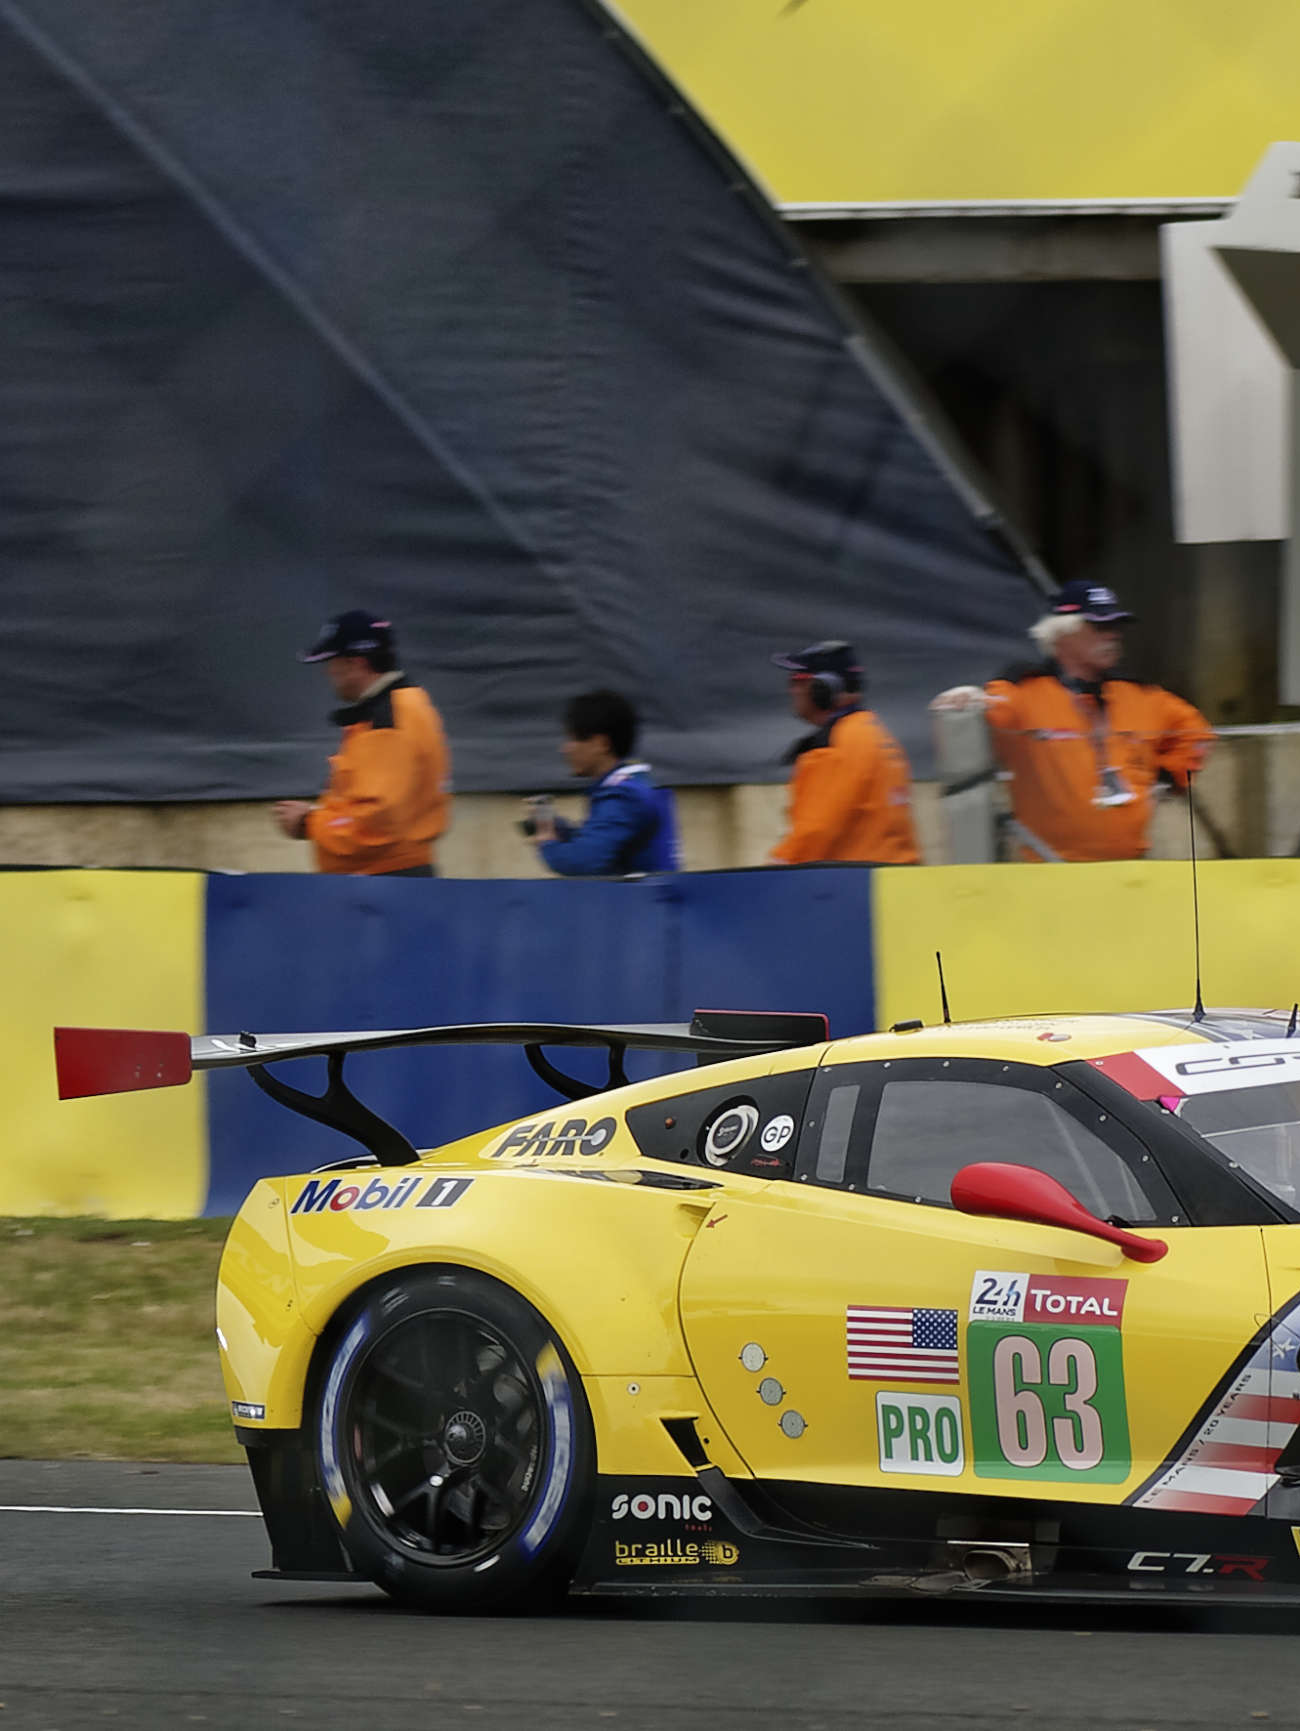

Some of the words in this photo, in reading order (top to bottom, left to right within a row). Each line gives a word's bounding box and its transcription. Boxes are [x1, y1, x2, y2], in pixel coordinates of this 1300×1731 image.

[491, 1117, 617, 1157] FARO
[764, 1126, 791, 1143] GP
[290, 1178, 421, 1214] Mobil
[972, 1305, 987, 1315] LE
[986, 1307, 1017, 1317] MANS
[1030, 1289, 1118, 1317] TOTAL
[993, 1335, 1105, 1471] 63
[881, 1404, 960, 1464] PRO
[1162, 1448, 1199, 1486] MANS
[1203, 1419, 1220, 1436] 20
[1217, 1374, 1251, 1417] YEARS
[615, 1539, 699, 1557] braille
[1127, 1552, 1269, 1581] C7.R
